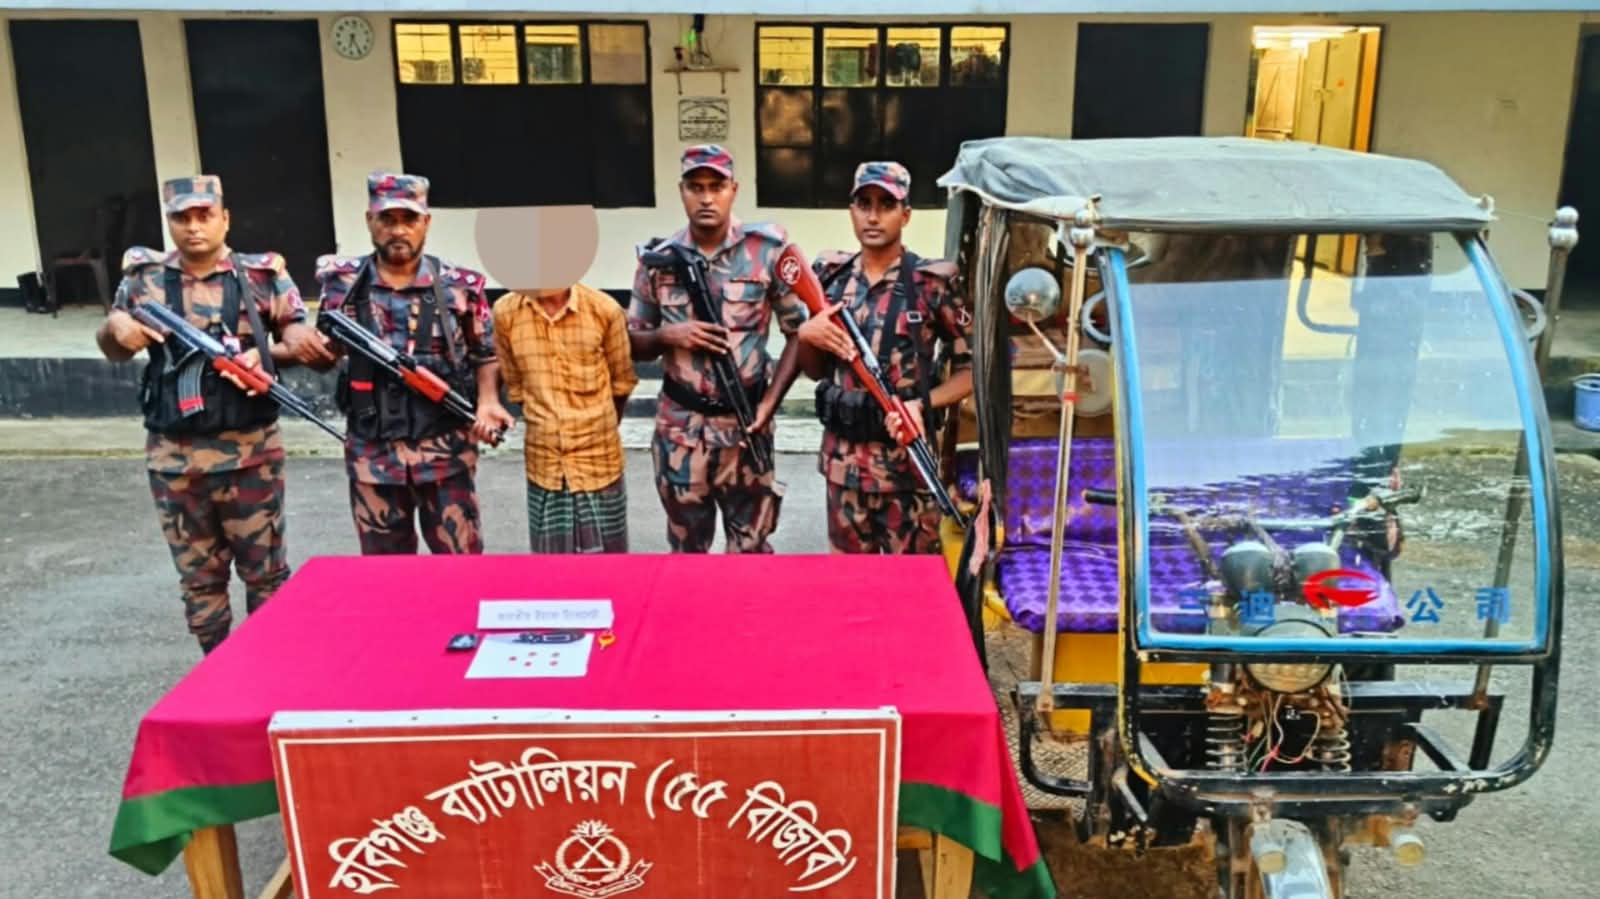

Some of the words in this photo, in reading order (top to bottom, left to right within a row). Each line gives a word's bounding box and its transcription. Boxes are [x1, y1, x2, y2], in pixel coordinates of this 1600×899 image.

[1405, 587, 1511, 624] 公司
[328, 806, 447, 894] হবিগঞ্জ
[424, 747, 637, 824] ব্যাটালিয়ন
[645, 758, 728, 819] (৫৫
[727, 780, 857, 891] বিজিবি)
